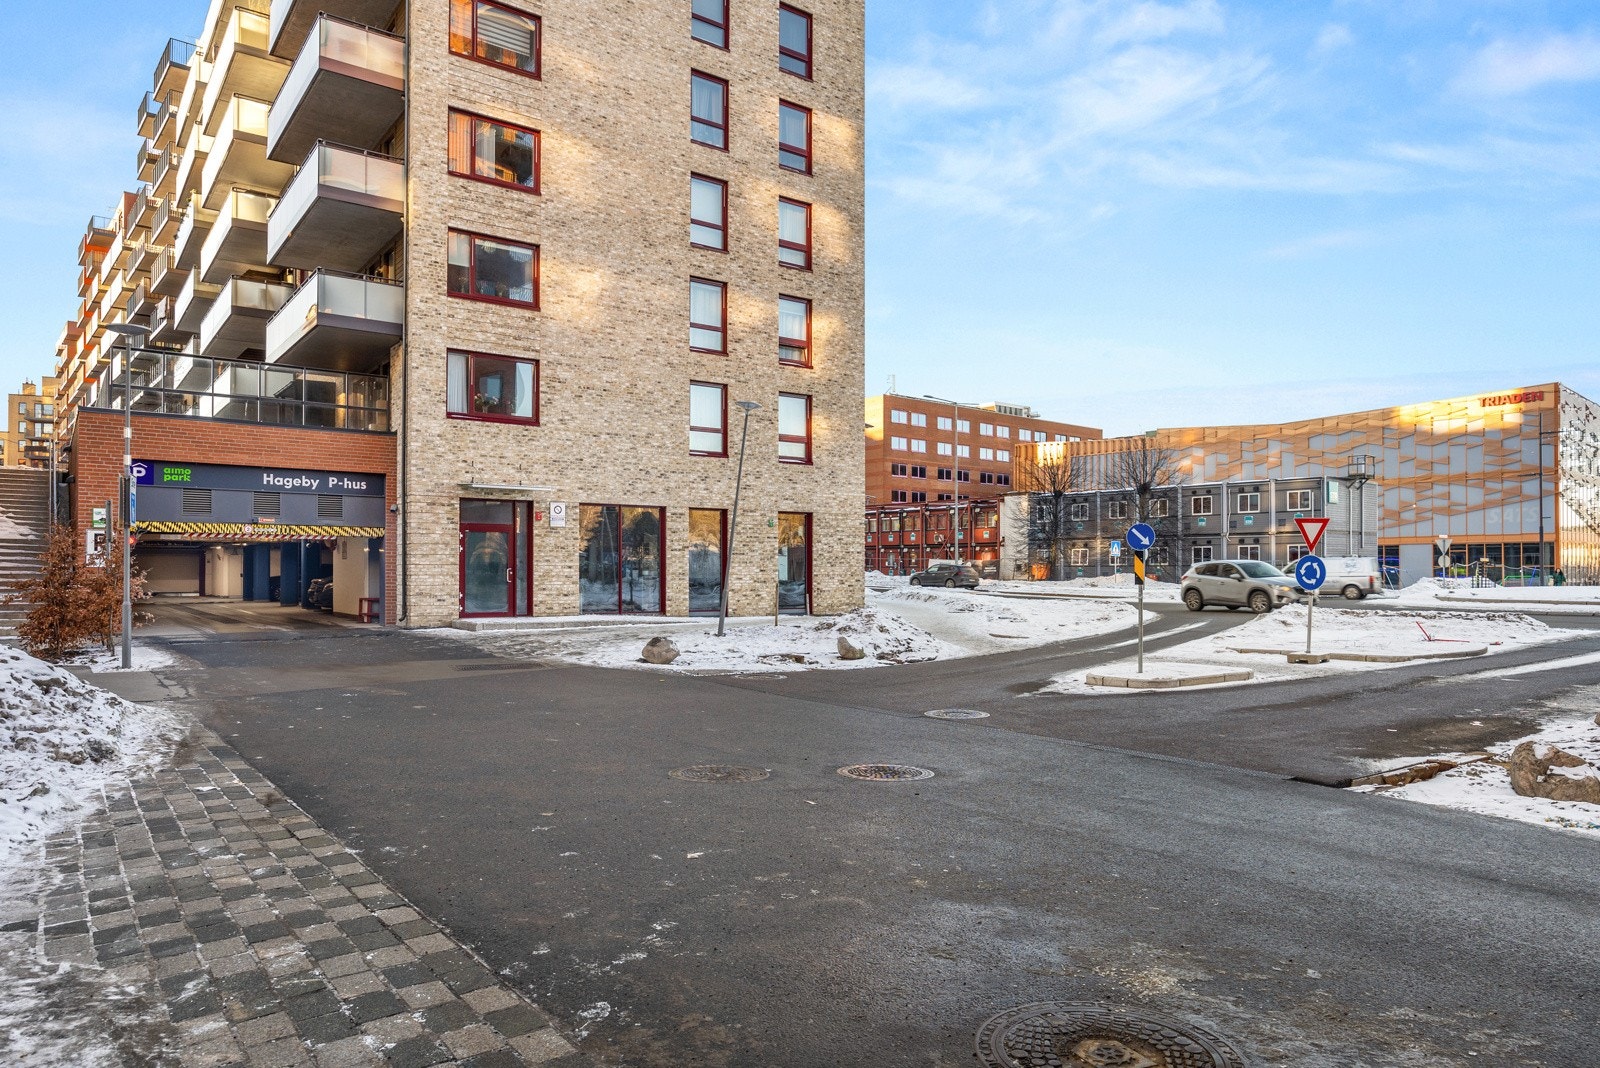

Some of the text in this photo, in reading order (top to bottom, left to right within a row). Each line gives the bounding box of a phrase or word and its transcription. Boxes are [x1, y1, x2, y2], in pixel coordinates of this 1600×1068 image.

[1479, 391, 1544, 407] TRIADEN
[163, 467, 191, 475] aimo
[163, 474, 191, 482] park
[263, 473, 367, 490] Hageby P-hus
